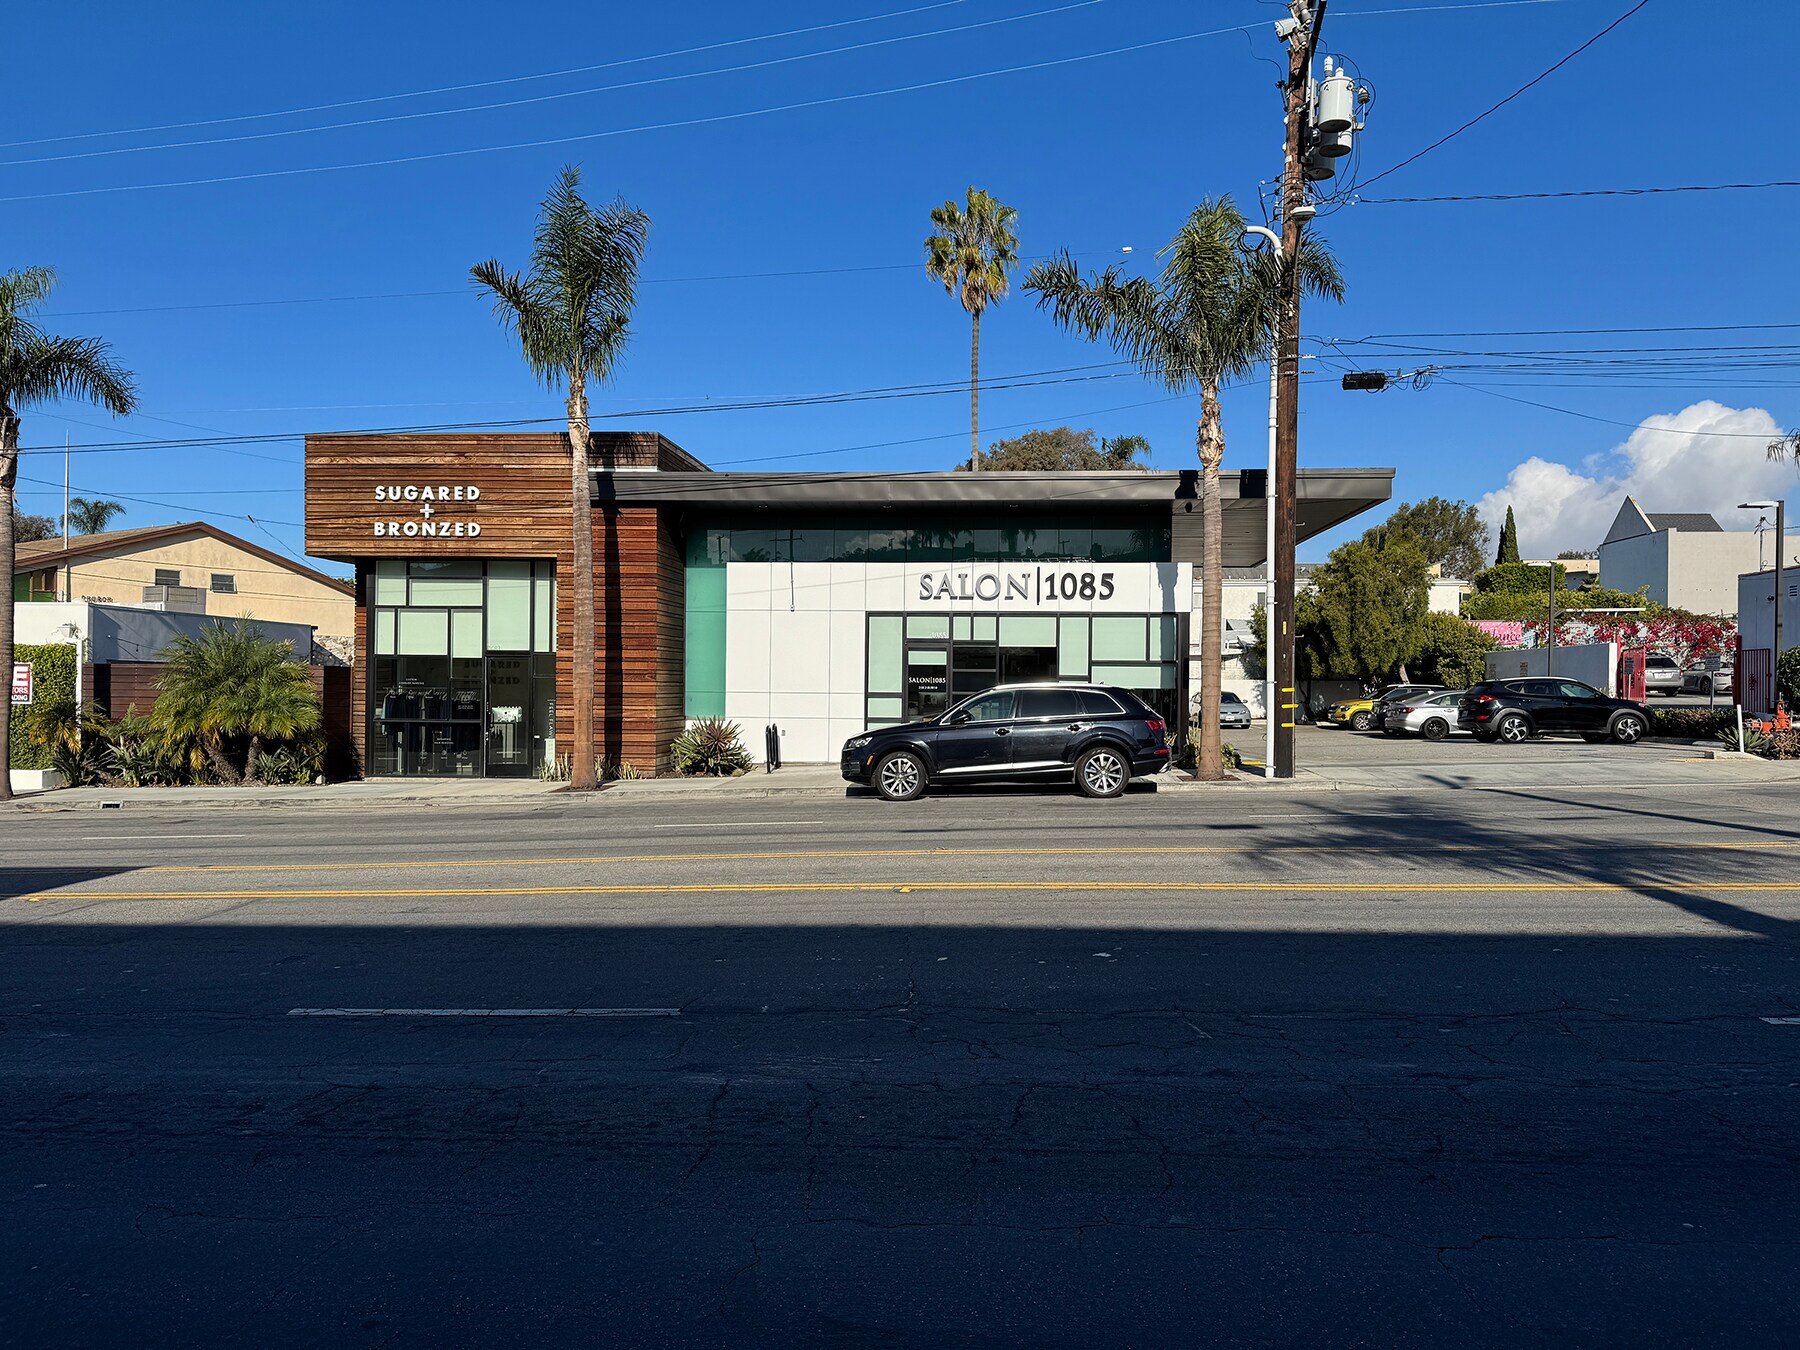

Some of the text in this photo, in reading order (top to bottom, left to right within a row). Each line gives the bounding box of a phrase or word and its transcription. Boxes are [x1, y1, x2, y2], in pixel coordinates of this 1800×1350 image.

[375, 485, 480, 500] SUGARED
[420, 503, 435, 518] +
[374, 521, 481, 537] BRONZED
[919, 572, 1115, 601] SALON 1085
[464, 661, 520, 669] SUARED
[464, 676, 520, 685] BRNZED
